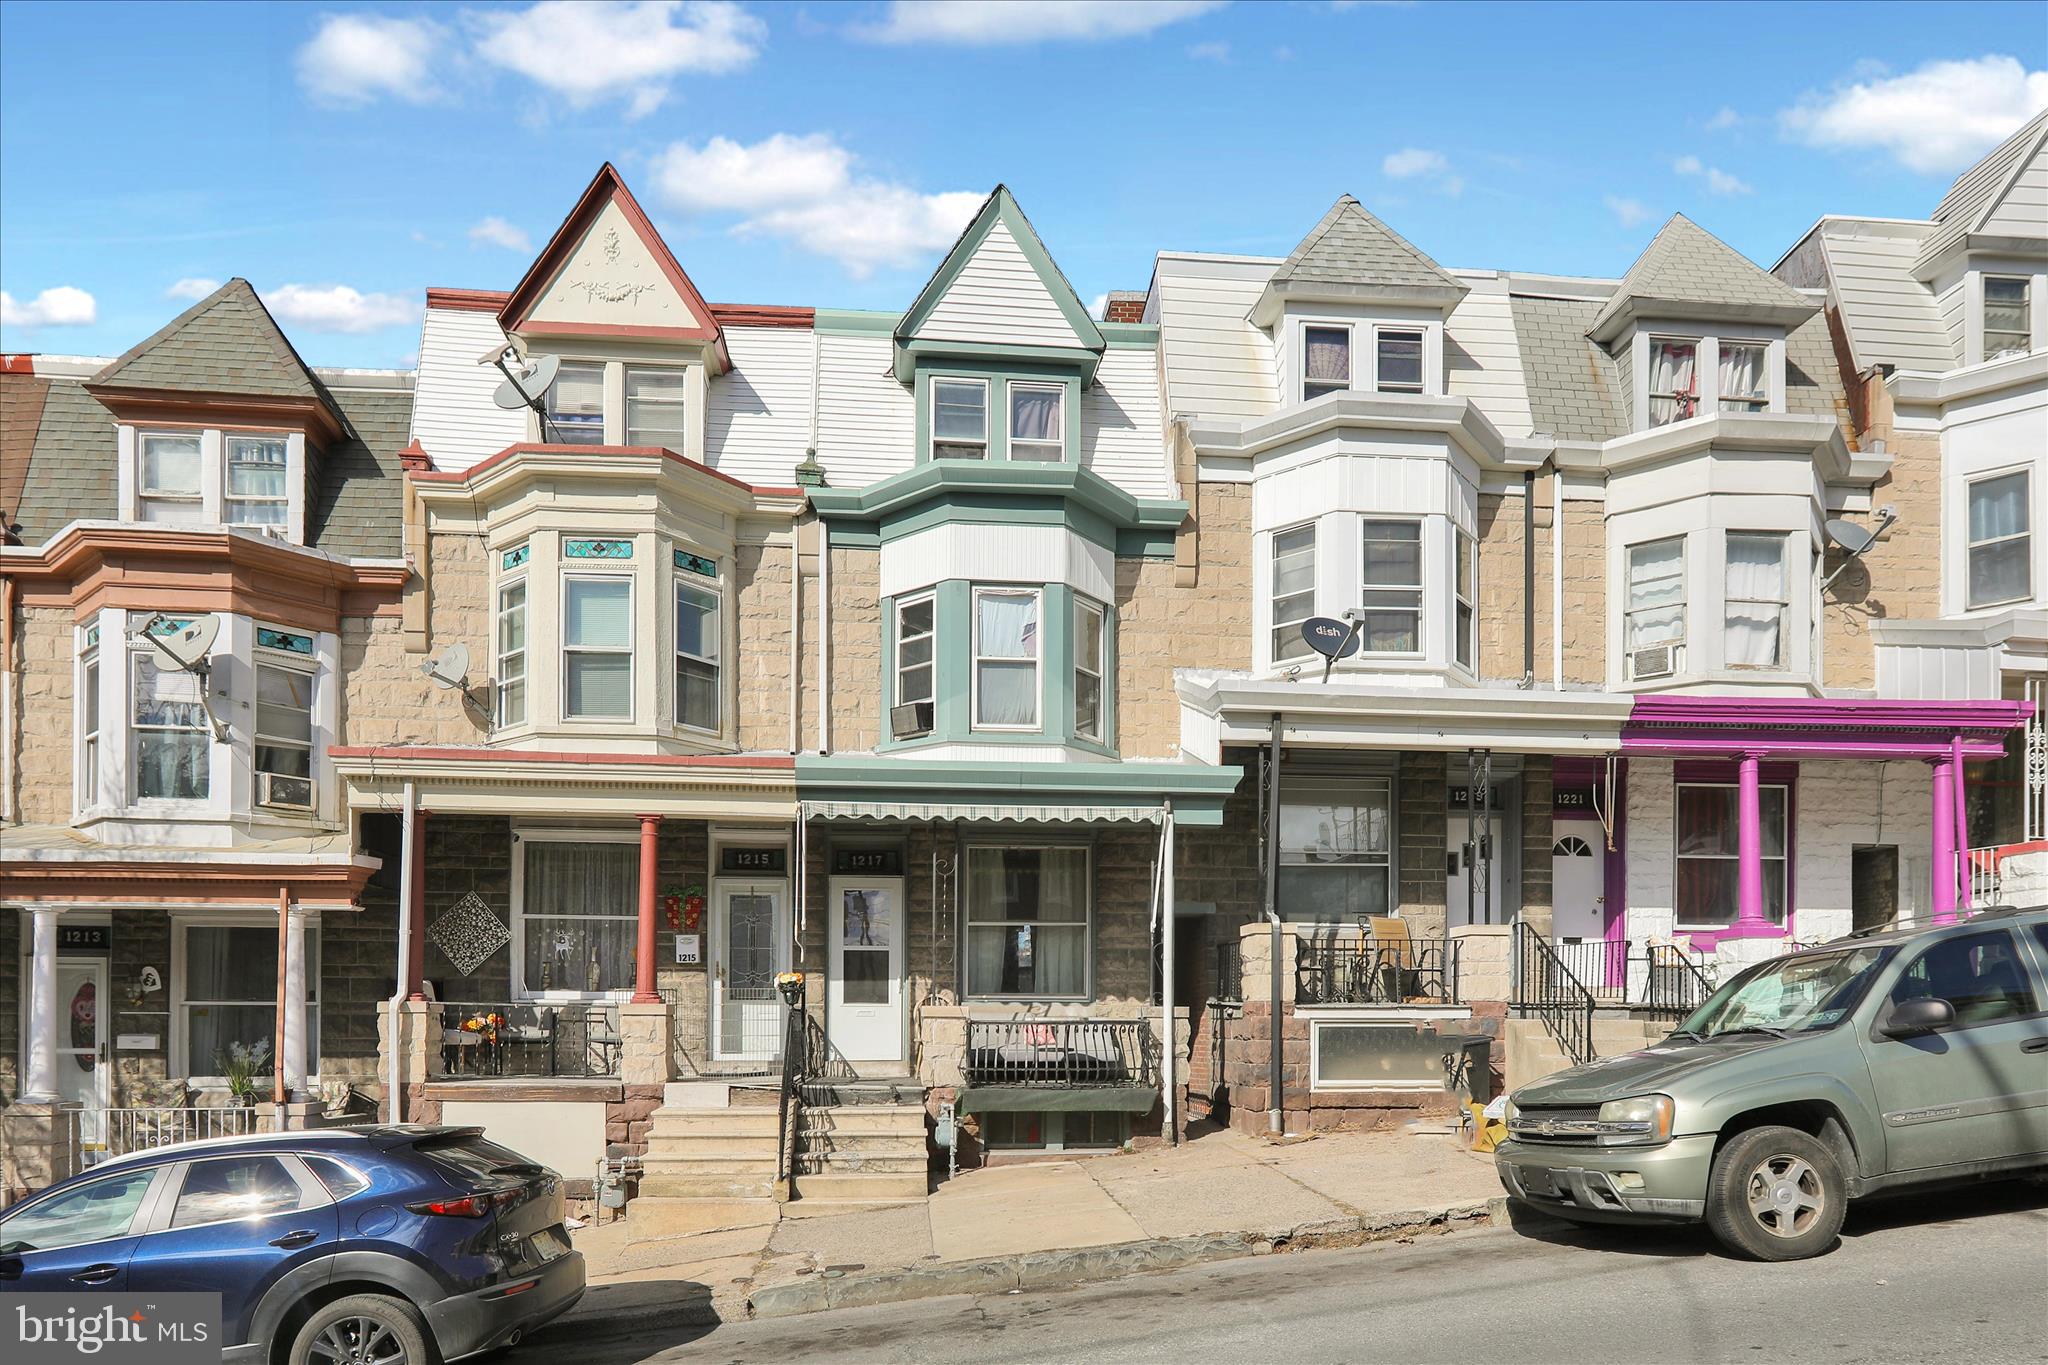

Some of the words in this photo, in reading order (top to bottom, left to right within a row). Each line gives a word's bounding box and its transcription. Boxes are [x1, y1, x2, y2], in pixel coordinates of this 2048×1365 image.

[1315, 625, 1341, 637] dish
[1455, 791, 1483, 801] 129
[1558, 794, 1583, 804] 1221
[737, 854, 769, 864] 1215
[852, 855, 882, 865] 1217
[66, 931, 102, 942] 1213
[678, 953, 697, 962] 1215
[500, 1231, 519, 1241] CX-30
